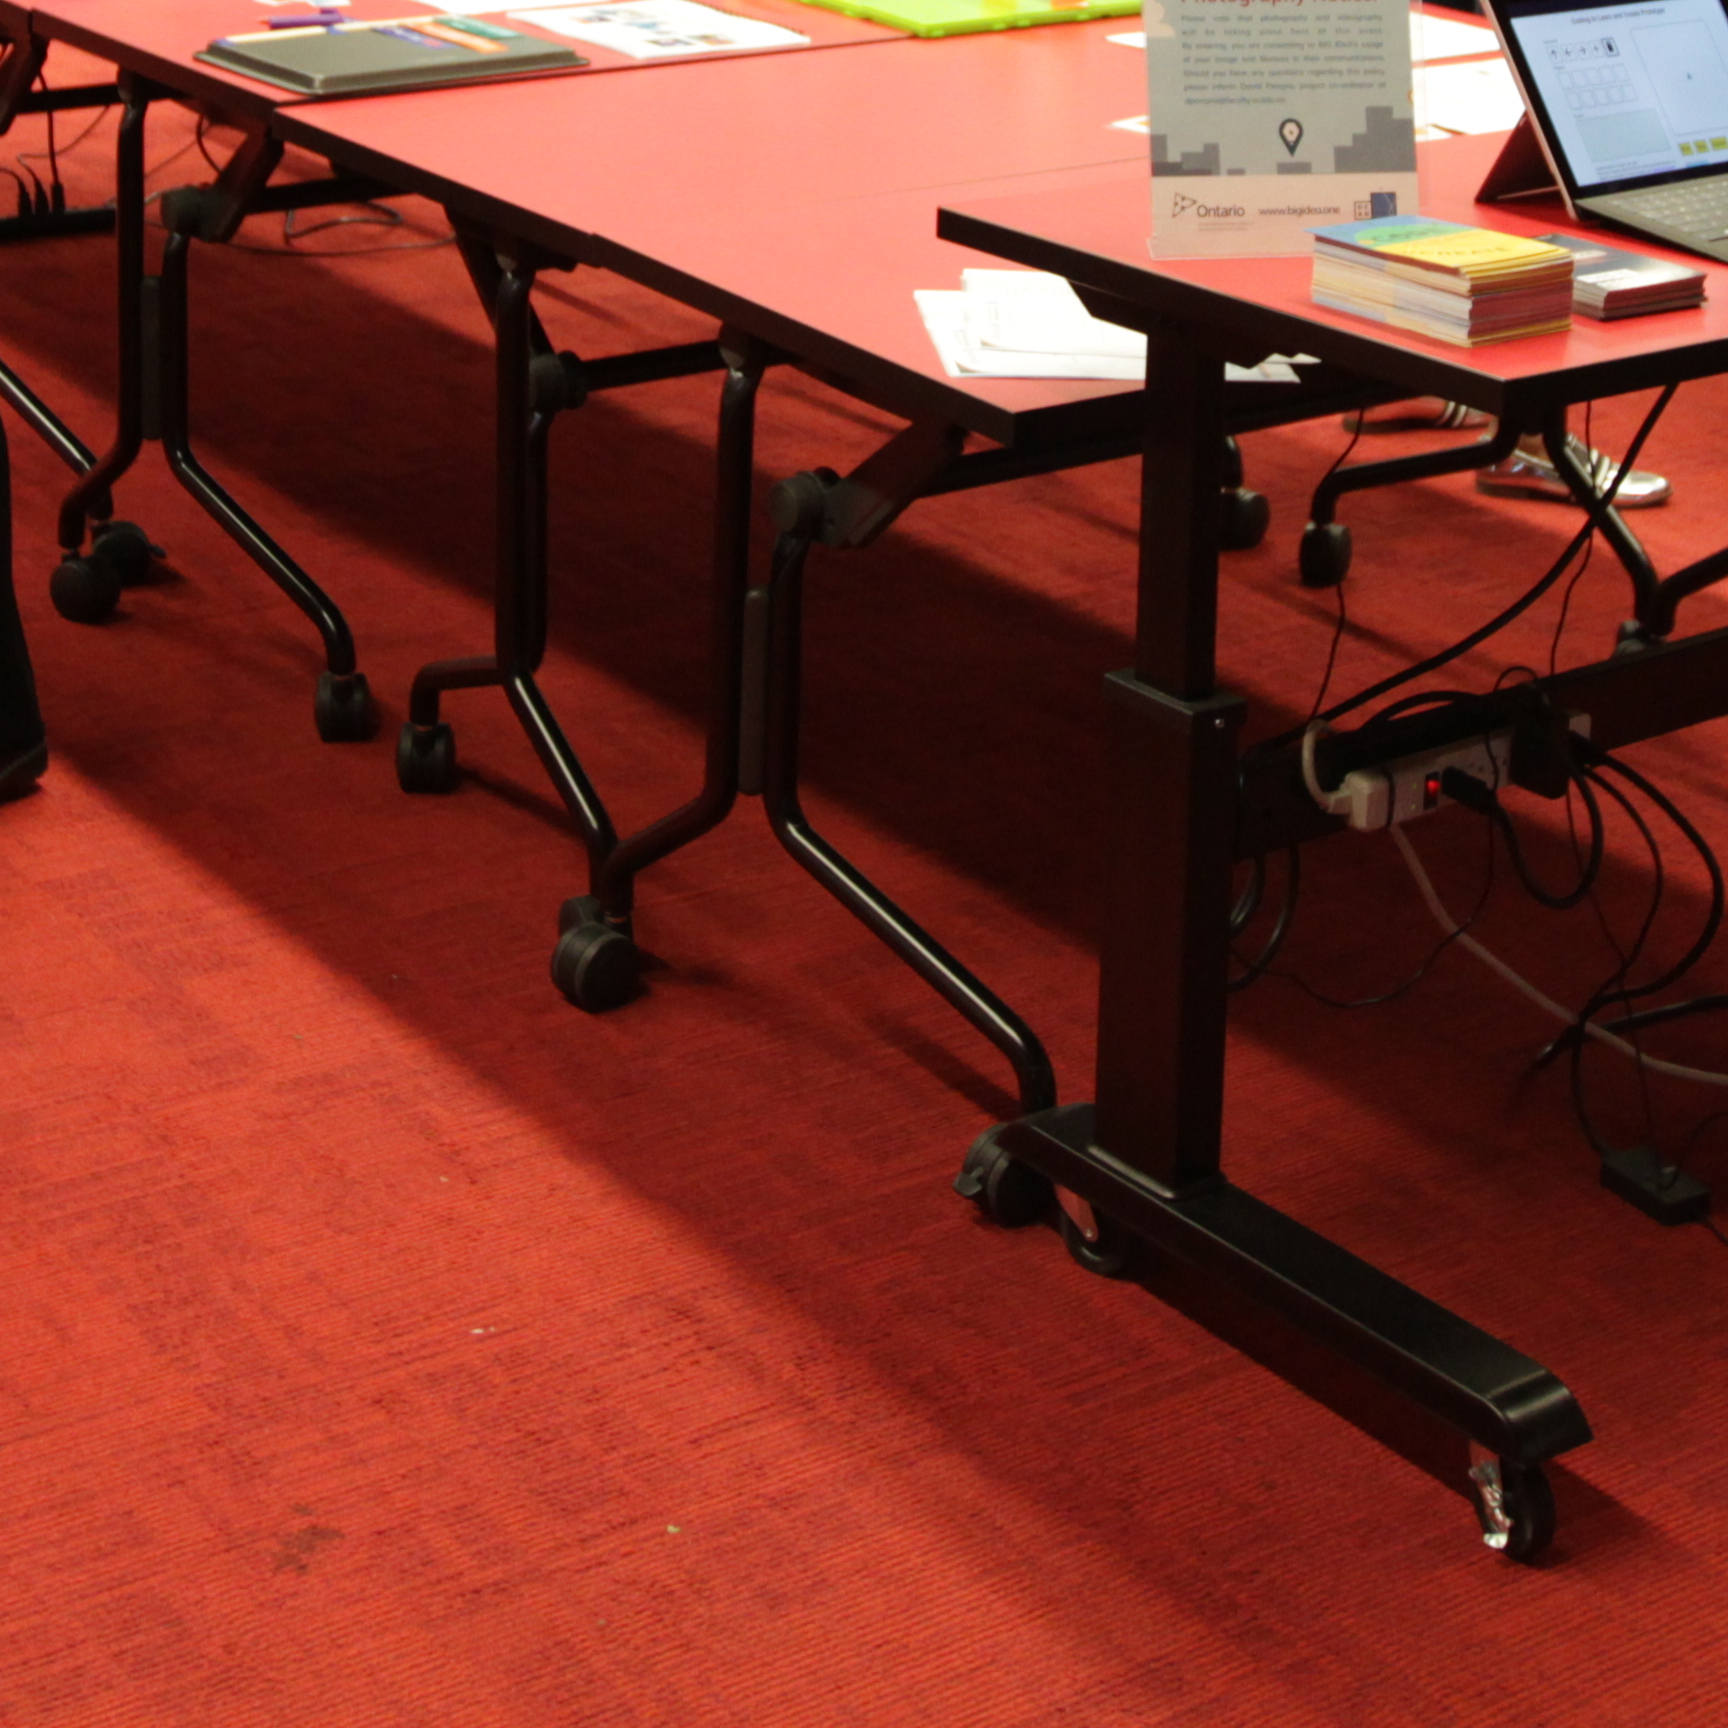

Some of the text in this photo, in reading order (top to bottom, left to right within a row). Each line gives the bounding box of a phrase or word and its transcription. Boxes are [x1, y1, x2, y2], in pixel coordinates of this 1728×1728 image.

[1237, 14, 1253, 22] that
[1260, 14, 1308, 24] photography
[1315, 14, 1330, 22] and
[1337, 13, 1383, 23] videography
[1224, 29, 1251, 39] taking
[1181, 41, 1192, 51] By
[1231, 42, 1246, 51] you
[1318, 40, 1332, 48] BIG
[1182, 55, 1190, 63] of
[1194, 56, 1211, 65] your
[1214, 55, 1238, 65] image
[1241, 55, 1256, 63] and
[1183, 70, 1210, 78] Should
[1212, 70, 1226, 78] you
[1229, 69, 1247, 77] have
[1251, 70, 1265, 78] any
[1268, 68, 1304, 78] questions
[1307, 68, 1344, 78] regarding
[1346, 67, 1360, 75] this
[1240, 81, 1262, 90] David
[1299, 82, 1326, 92] project
[1197, 204, 1341, 218] Ontario www.bigidea.one
